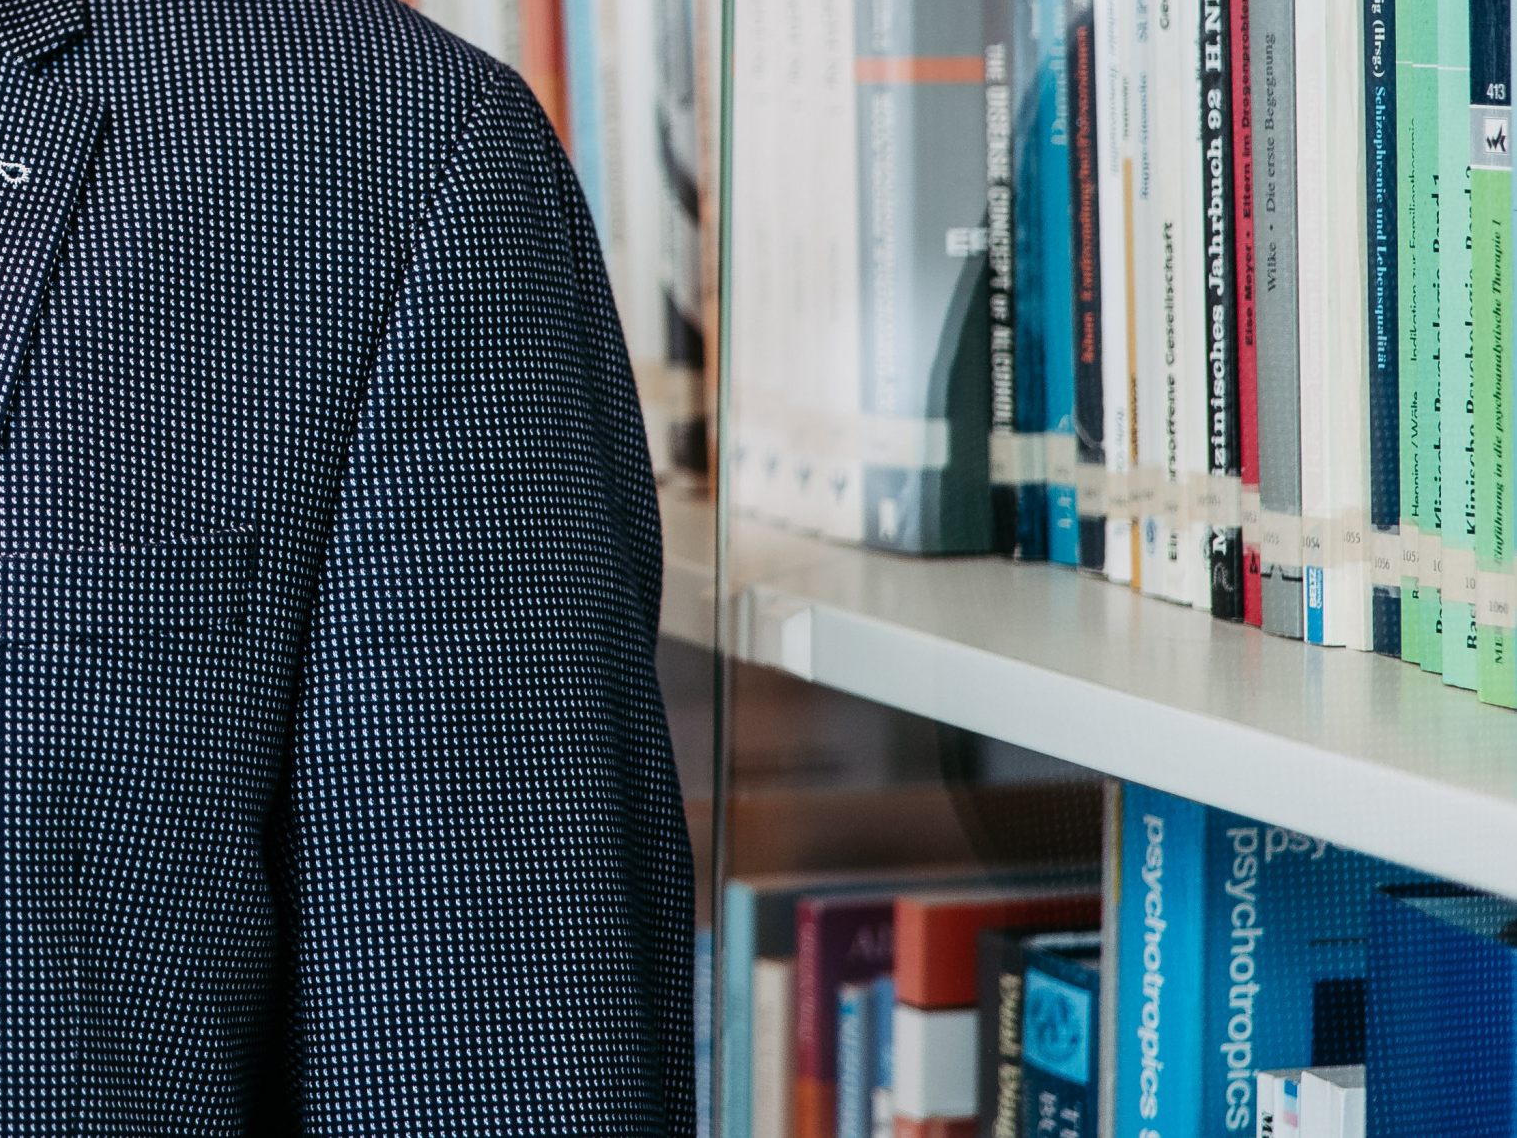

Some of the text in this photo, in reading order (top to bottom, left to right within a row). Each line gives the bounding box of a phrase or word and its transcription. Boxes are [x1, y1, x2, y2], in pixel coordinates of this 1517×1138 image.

[1371, 19, 1386, 78] (Hrsg.)
[1486, 83, 1506, 101] 413
[1206, 89, 1223, 130] 92
[1372, 86, 1387, 203] Schizophrenie
[1263, 32, 1278, 291] Wilke Die erste Begegnung
[1206, 139, 1225, 296] Jahrbuch
[1375, 208, 1387, 241] und
[1491, 231, 1504, 295] Therapie
[1162, 221, 1175, 366] Gesellschaft
[1243, 243, 1255, 300] Meyer
[1373, 246, 1388, 370] Lebensqualität
[1491, 299, 1505, 433] psychoanalytische
[1208, 305, 1227, 556] Mizinisches
[1491, 437, 1503, 459] die
[1492, 463, 1503, 479] in
[1491, 482, 1505, 565] Einführung
[1137, 814, 1167, 1120] psychotropics
[1220, 826, 1263, 1131] psychotropics
